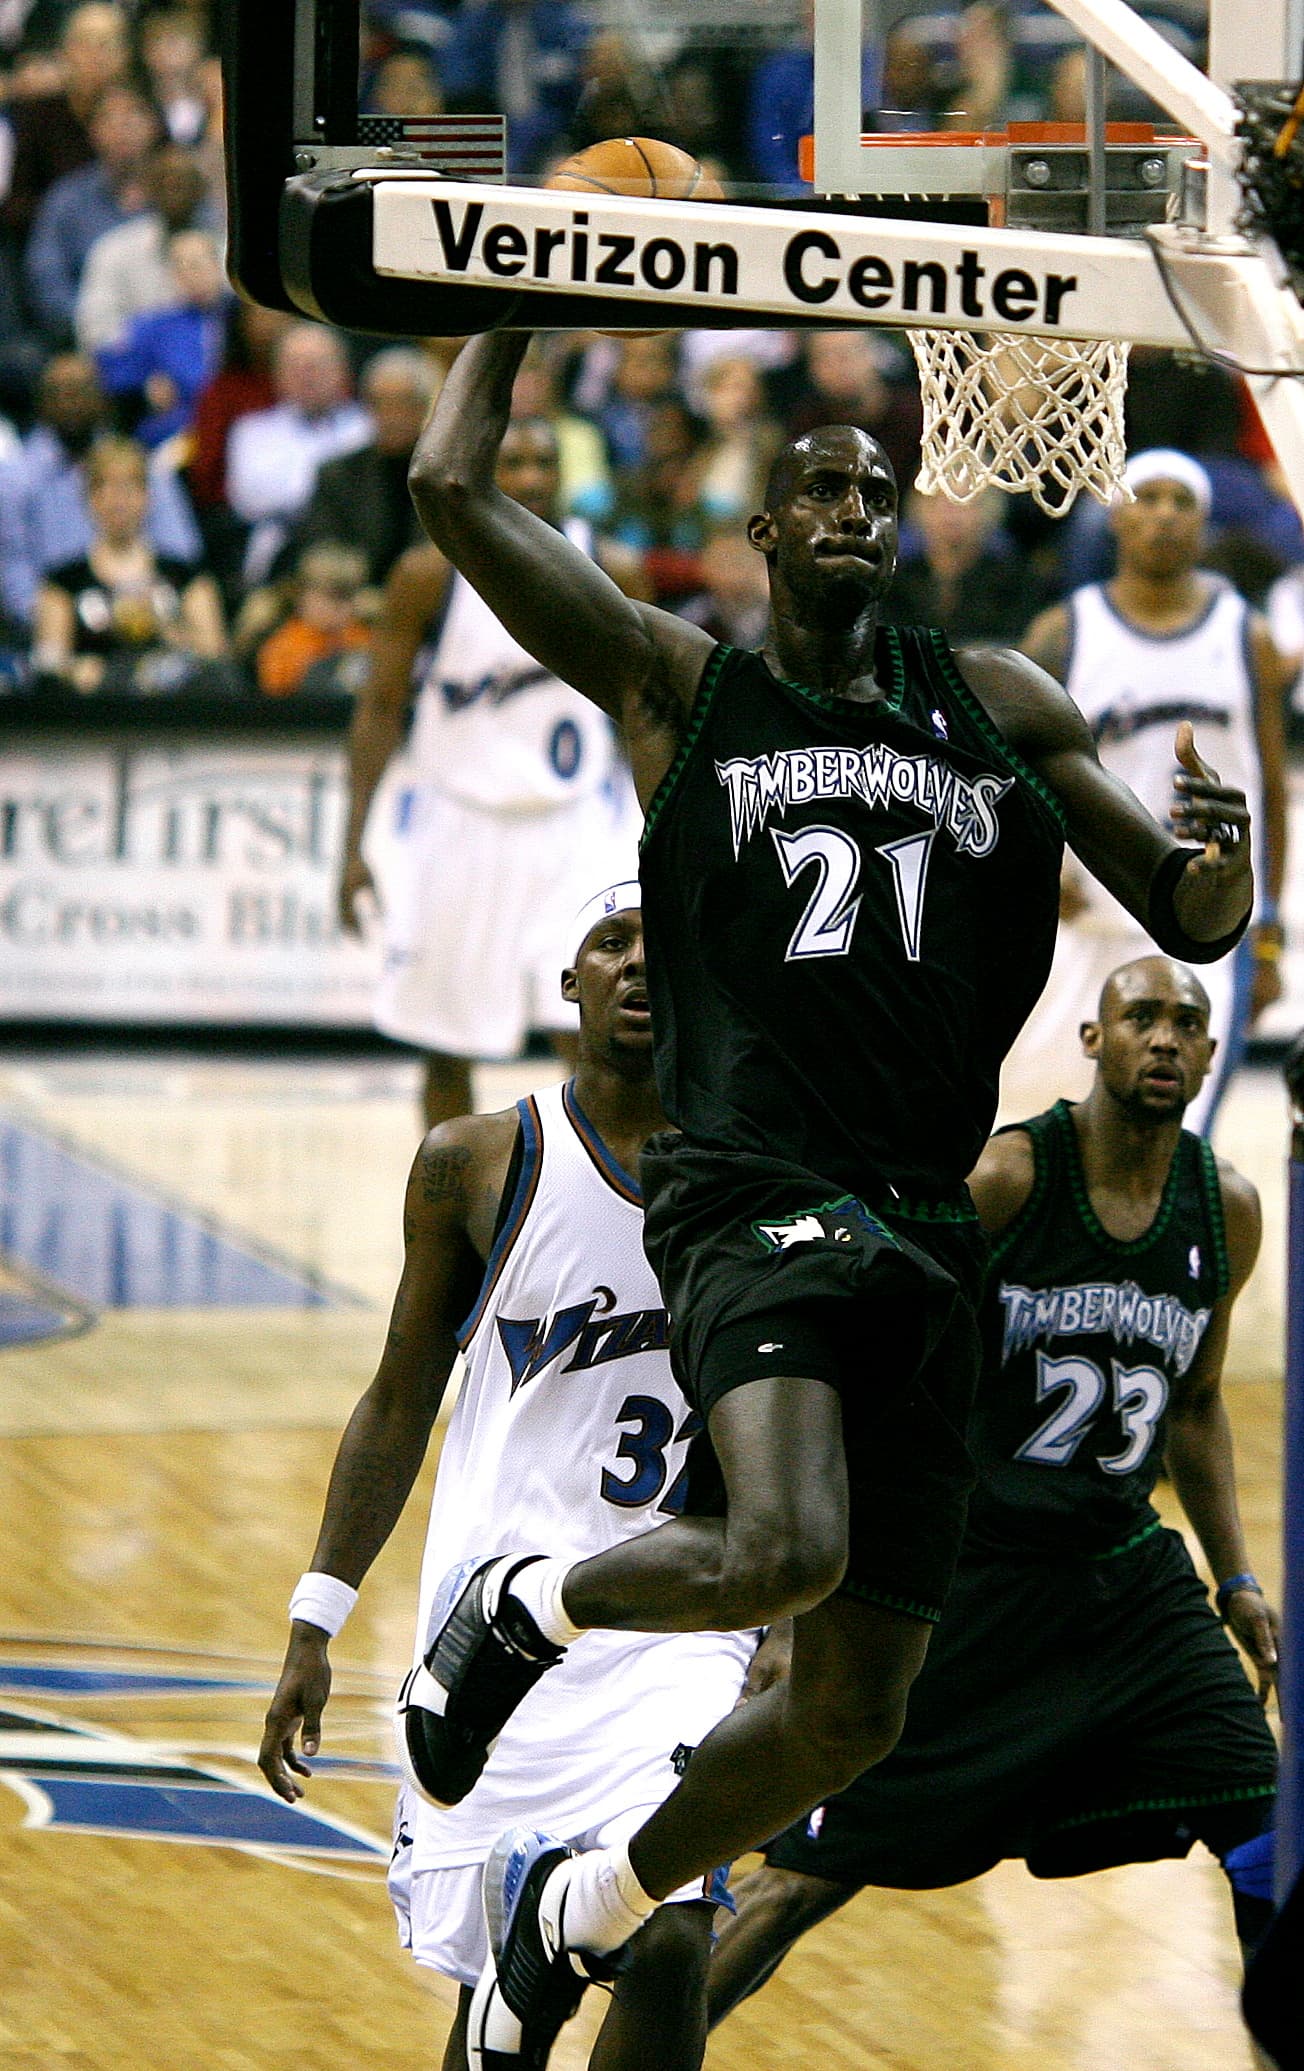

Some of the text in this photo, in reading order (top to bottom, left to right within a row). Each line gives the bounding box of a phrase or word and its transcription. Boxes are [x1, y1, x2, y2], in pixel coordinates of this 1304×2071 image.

[431, 198, 1077, 324] Verizon Center
[714, 743, 1015, 862] TIMBERWOLVES
[768, 824, 938, 962] 21
[495, 1285, 673, 1402] WIZA
[1013, 1350, 1169, 1475] 23
